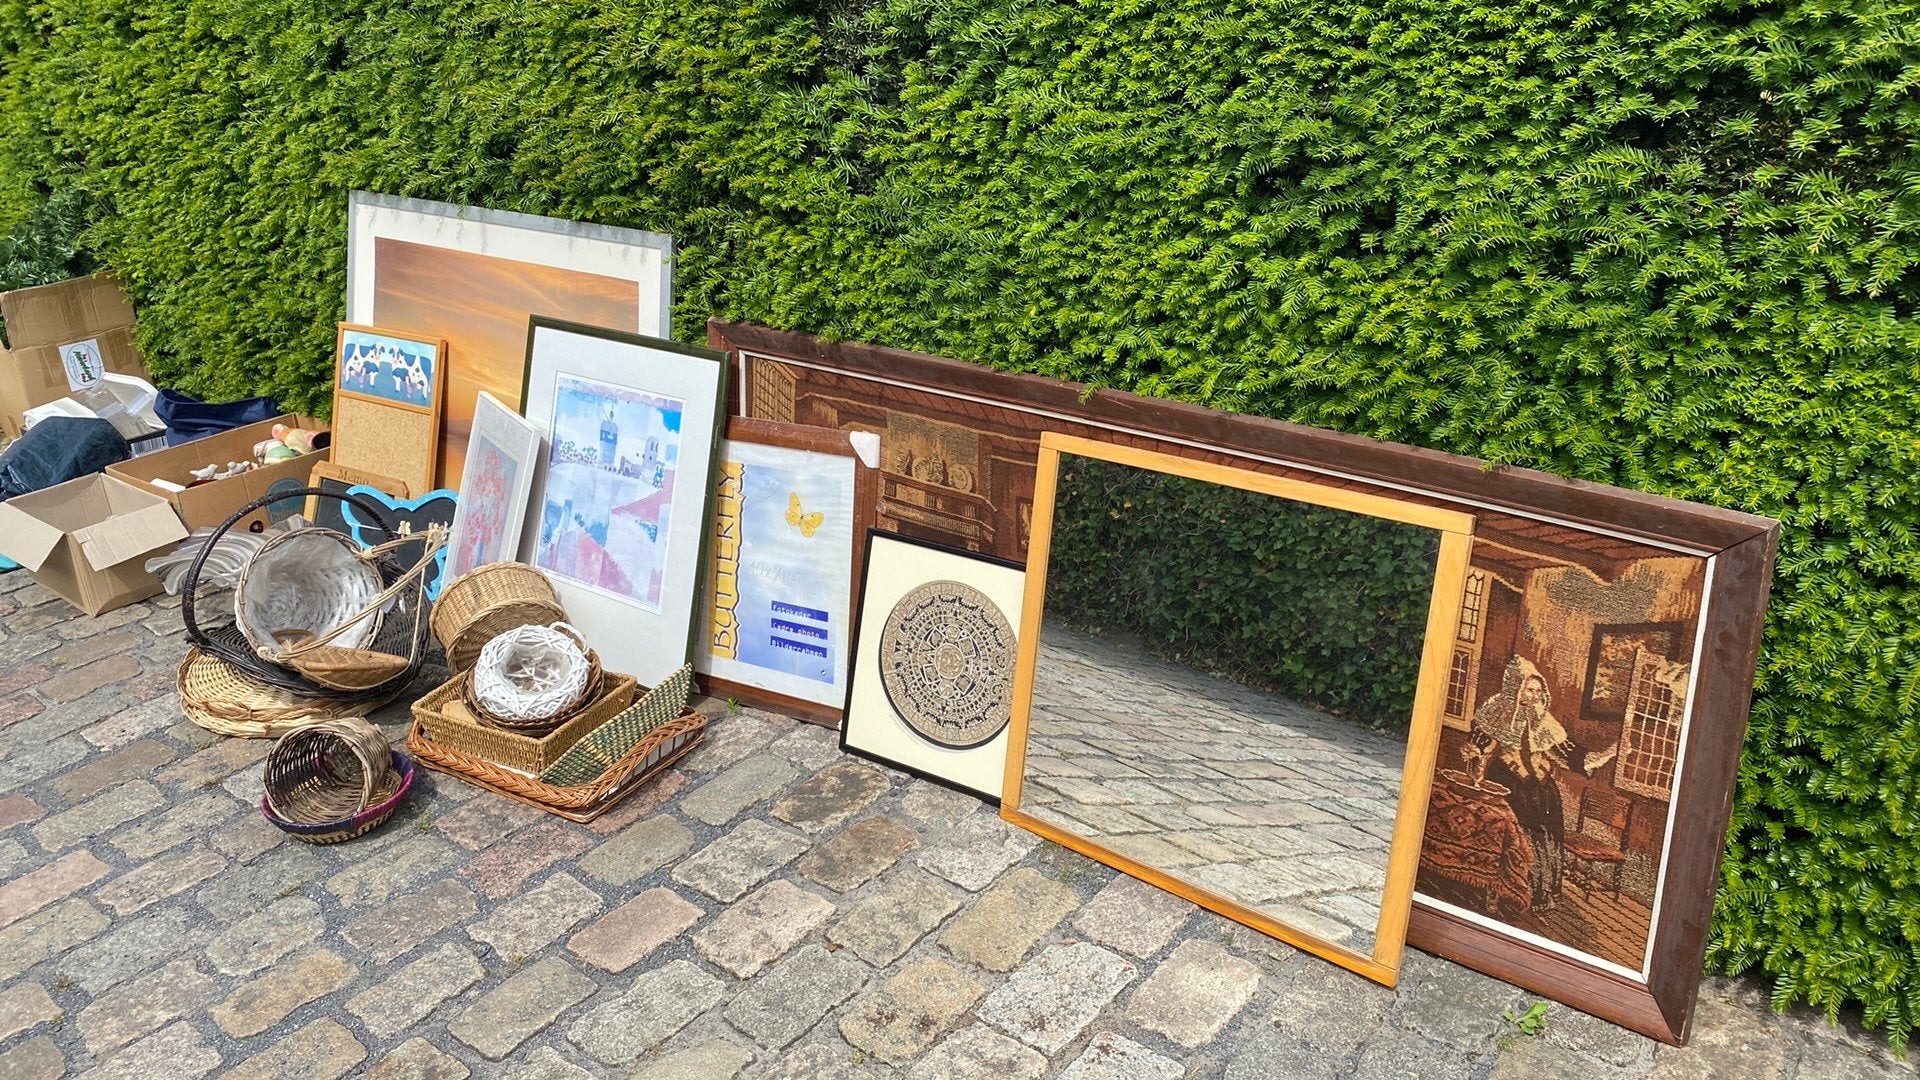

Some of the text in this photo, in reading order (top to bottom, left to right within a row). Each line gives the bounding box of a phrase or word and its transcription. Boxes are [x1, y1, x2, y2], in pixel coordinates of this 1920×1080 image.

[338, 469, 370, 485] Memo
[714, 468, 736, 649] BUTTERFLY
[798, 628, 820, 640] photo
[771, 639, 824, 658] Bilderrahmen
